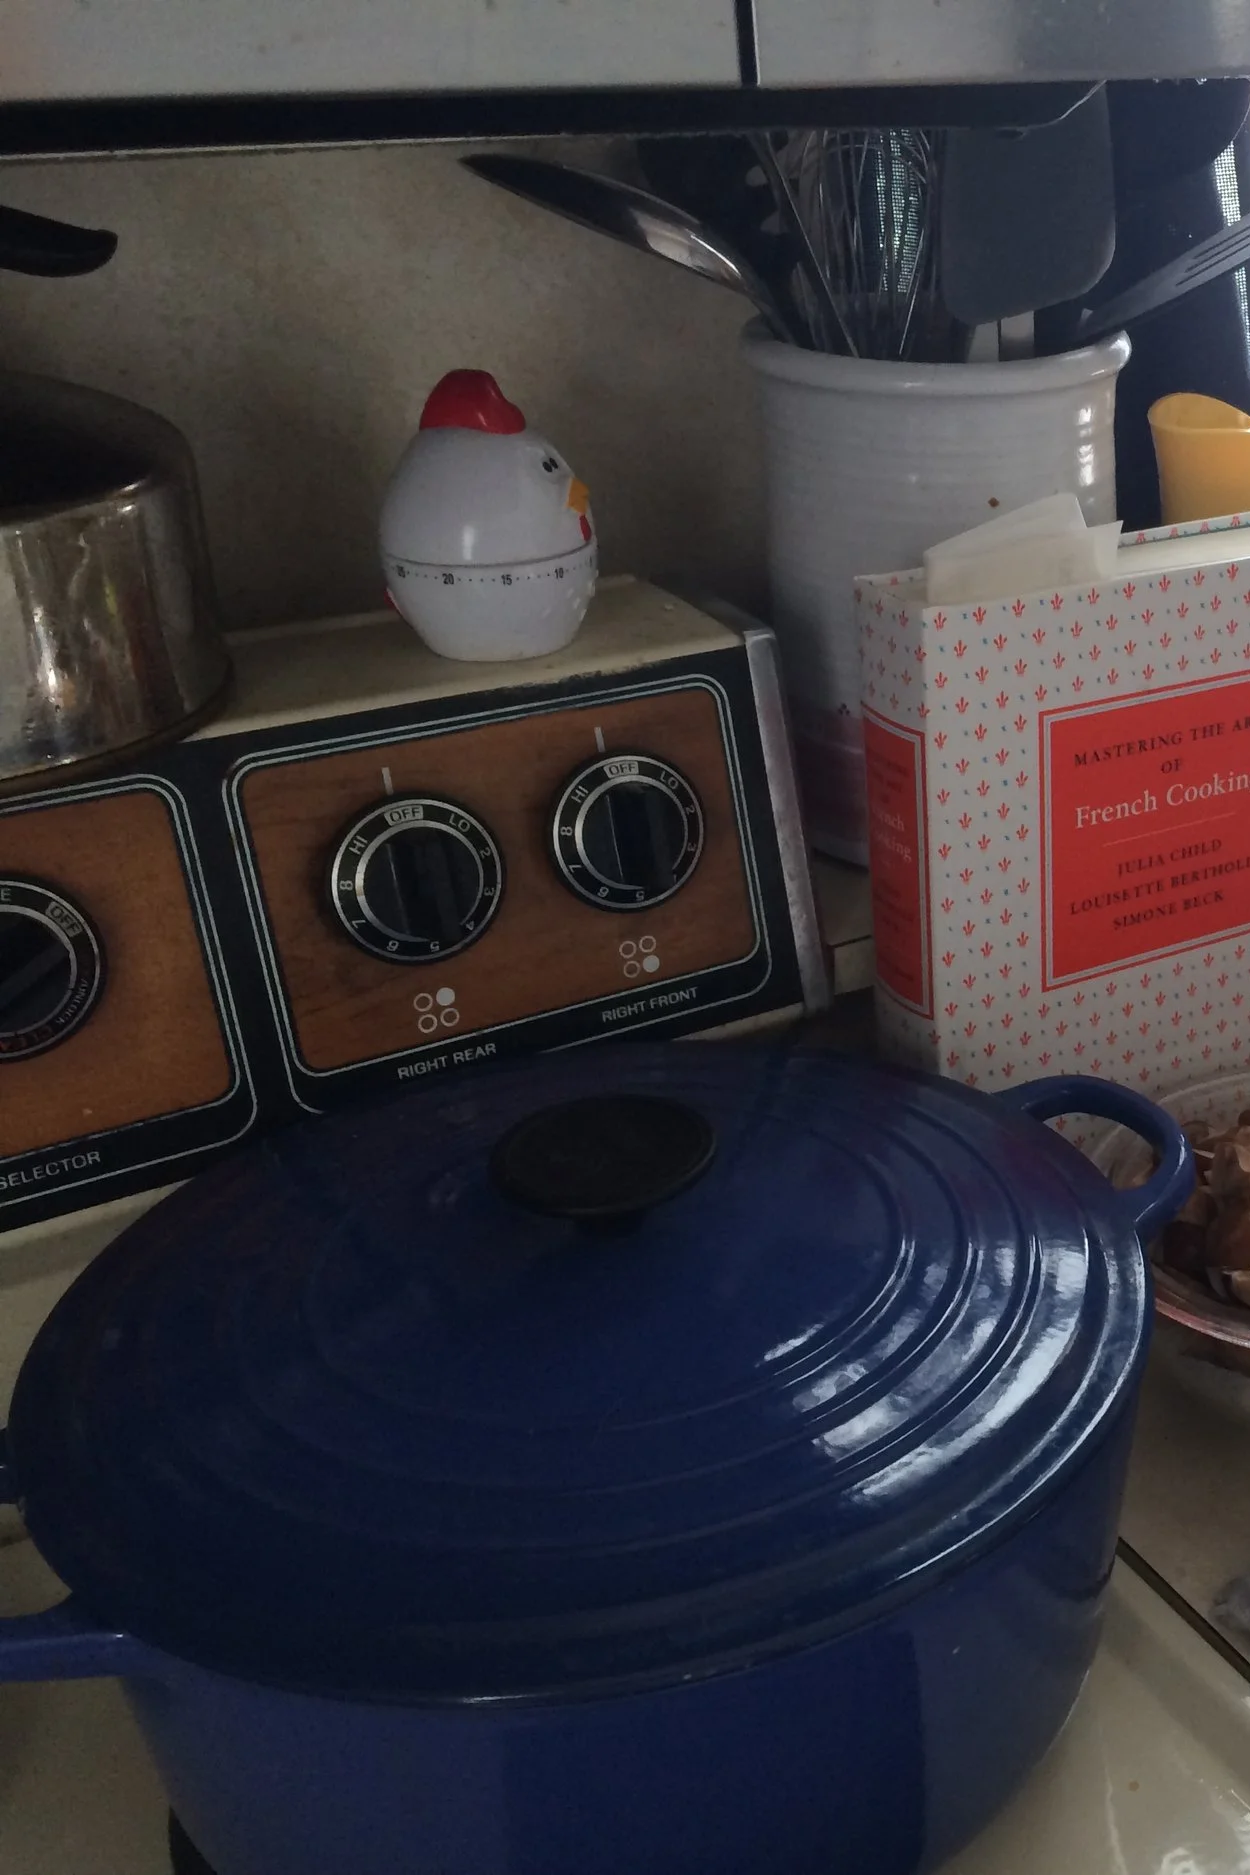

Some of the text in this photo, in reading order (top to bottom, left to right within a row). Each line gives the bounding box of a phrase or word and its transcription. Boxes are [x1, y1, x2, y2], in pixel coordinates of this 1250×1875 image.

[442, 573, 454, 586] 20
[501, 574, 512, 586] 15
[554, 567, 564, 579] 10
[1074, 731, 1183, 768] MASTERING
[1190, 722, 1225, 742] THE
[608, 763, 637, 777] OFF
[1160, 757, 1183, 775] OF
[660, 771, 679, 790] LO
[570, 785, 590, 803] HI
[390, 807, 421, 822] OFF
[1075, 790, 1158, 830] French
[449, 813, 471, 833] LO
[560, 825, 573, 836] 8
[349, 836, 369, 856] HI
[1117, 838, 1223, 877] JULIA CHILD
[339, 880, 353, 891] 8
[1070, 879, 1164, 915] LOUISETTE
[1112, 889, 1224, 931] SIMONE BECK
[49, 904, 81, 937] OFF
[601, 987, 699, 1023] RIGHT FRONT
[397, 1043, 497, 1080] RIGHT REAR
[0, 1151, 101, 1190] SELECTOR
